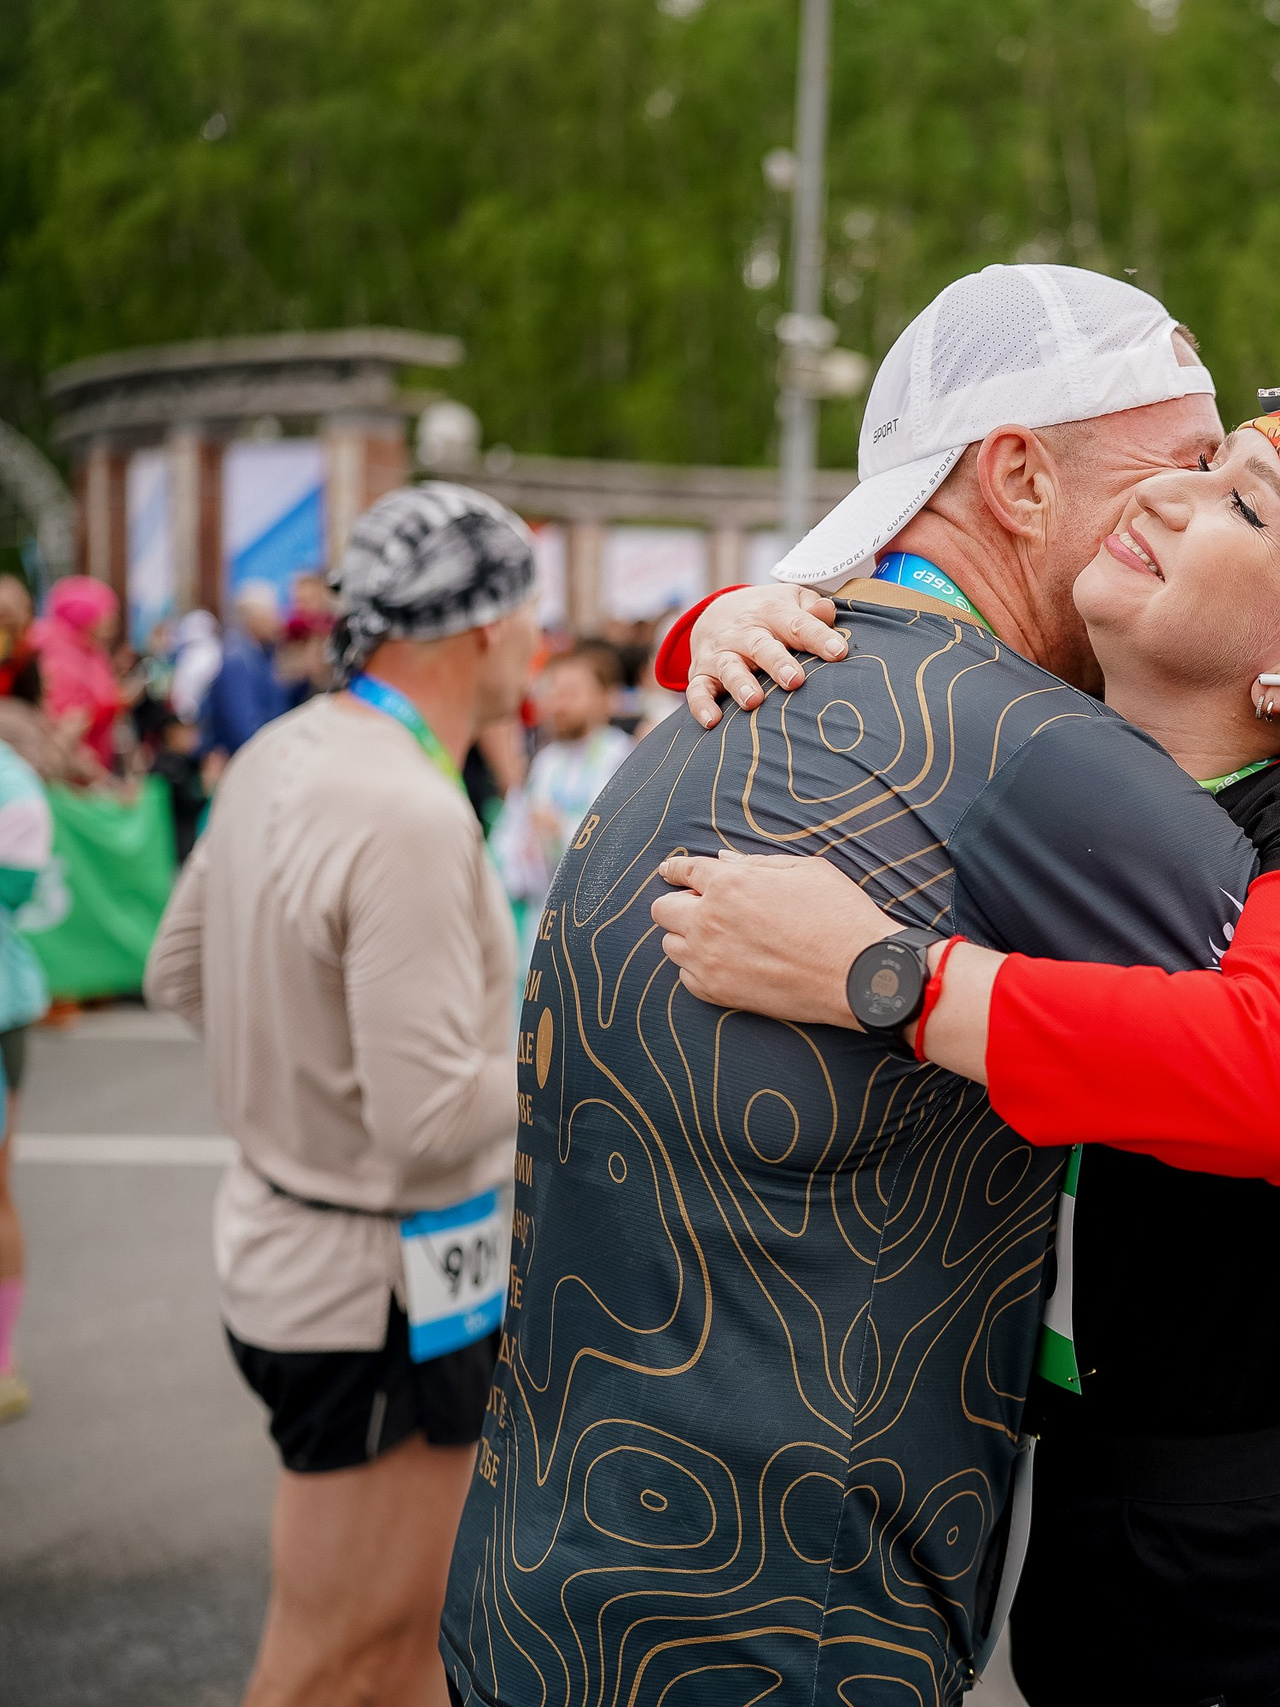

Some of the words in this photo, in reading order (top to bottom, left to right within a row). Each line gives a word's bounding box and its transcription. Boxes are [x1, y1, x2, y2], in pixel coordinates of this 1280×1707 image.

[873, 417, 899, 444] SPORT
[832, 549, 865, 573] SPORT
[928, 449, 956, 486] SPORT
[912, 569, 955, 595] СБЕР
